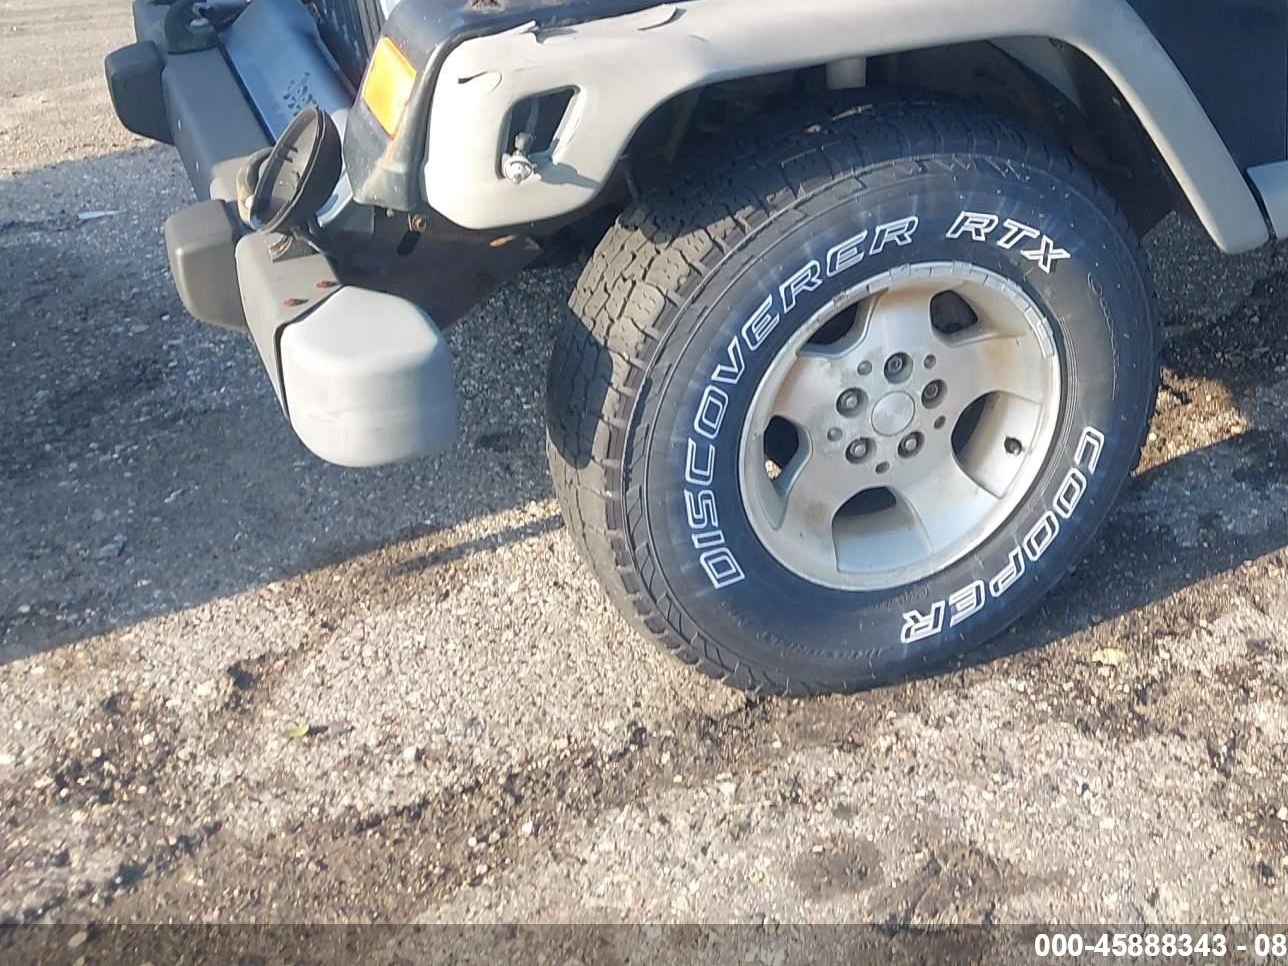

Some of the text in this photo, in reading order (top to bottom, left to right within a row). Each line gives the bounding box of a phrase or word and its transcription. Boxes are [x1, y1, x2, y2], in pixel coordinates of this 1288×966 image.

[684, 215, 919, 590] DISCOVERER
[945, 210, 1072, 274] RTX
[900, 425, 1105, 644] COOPER
